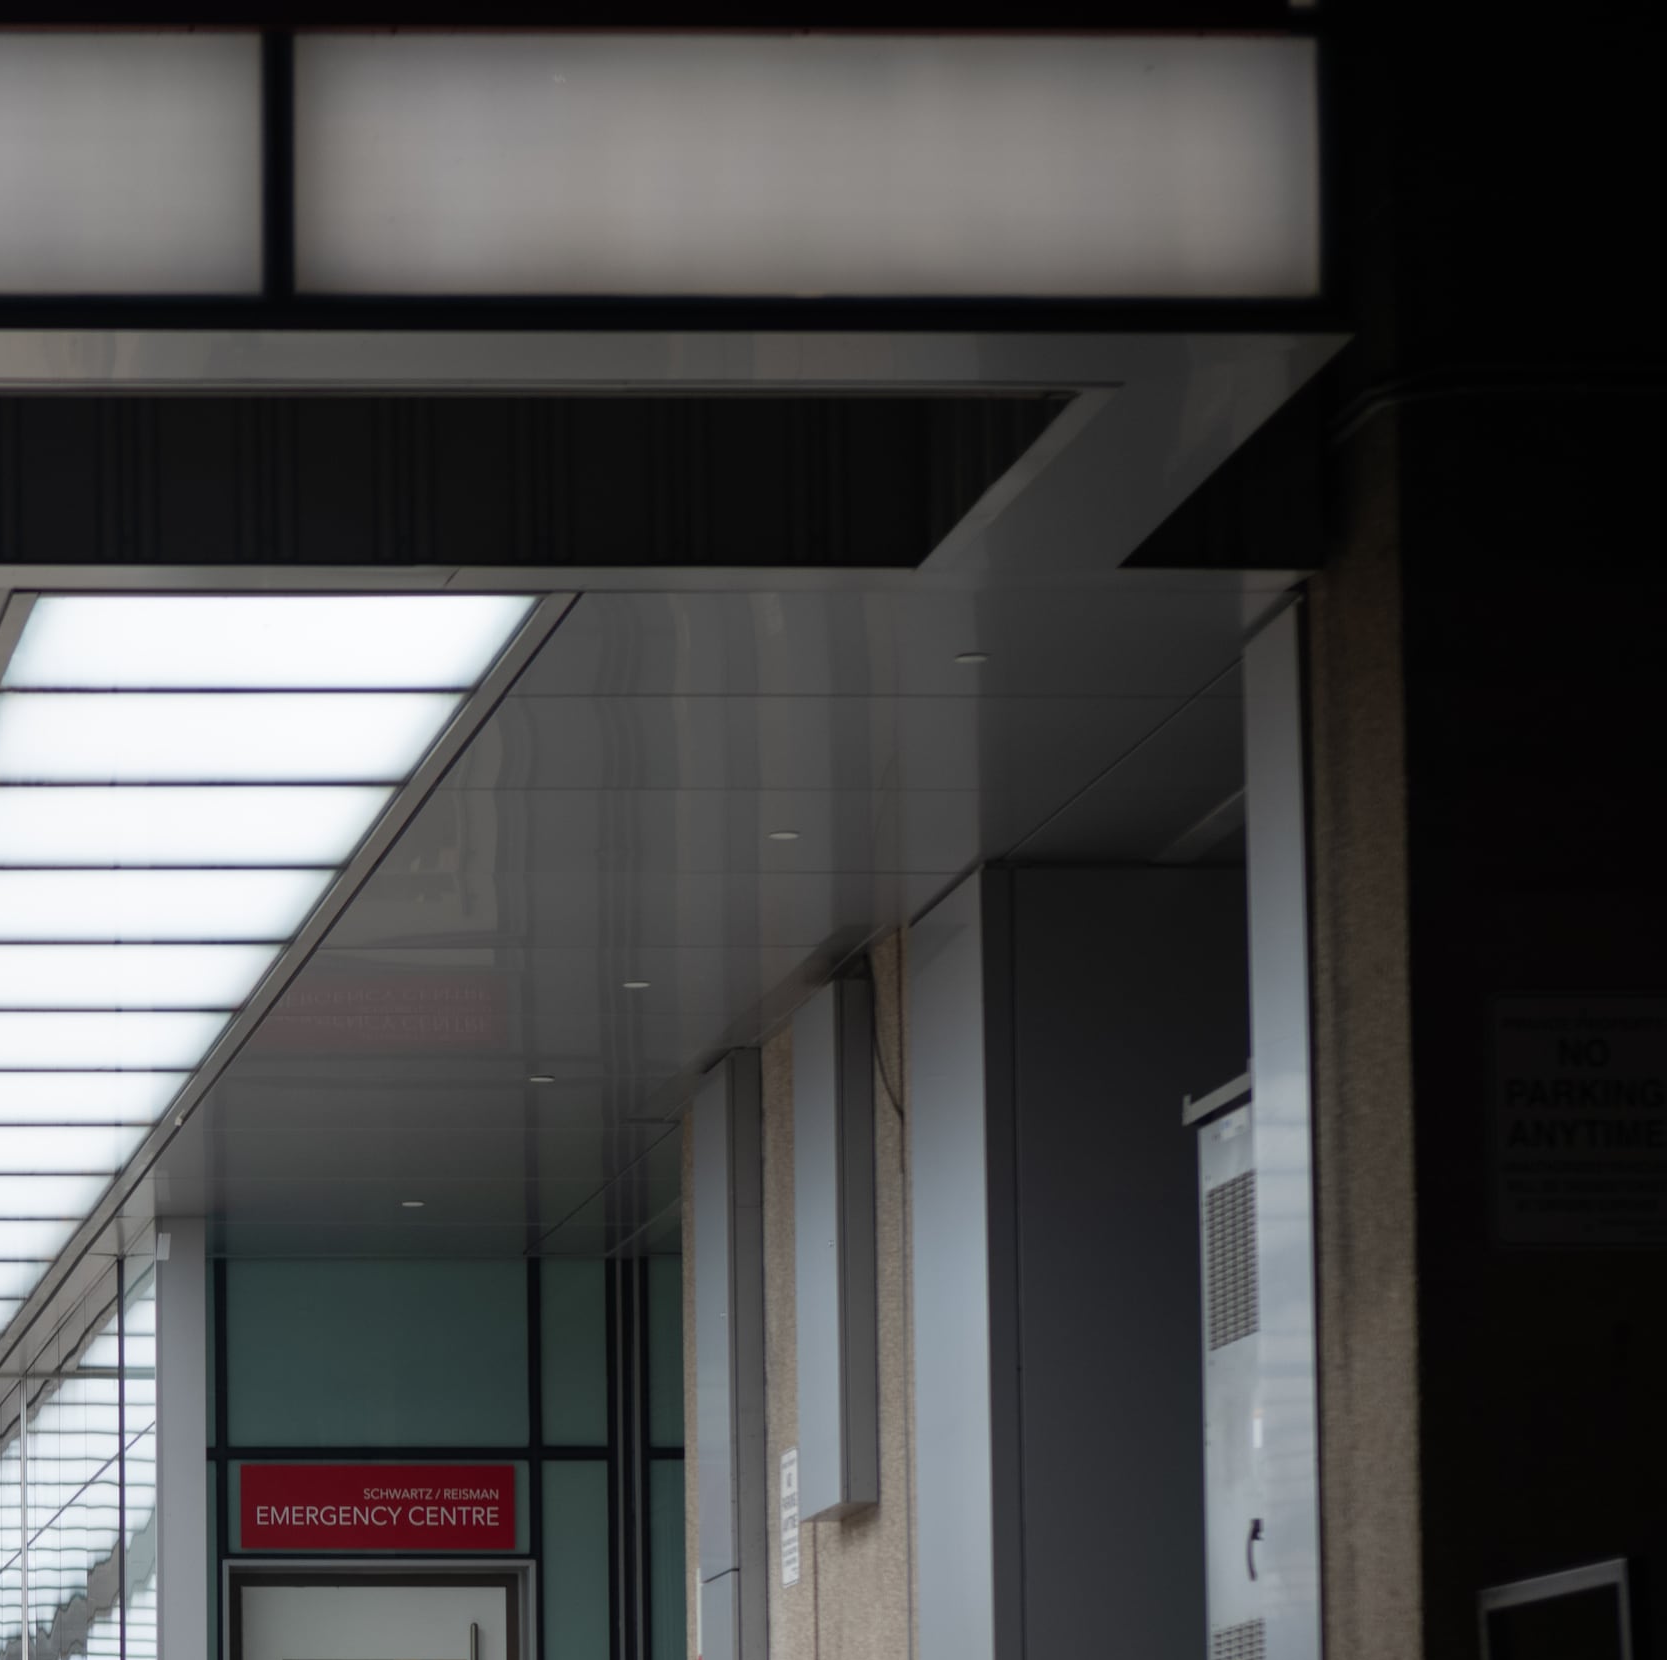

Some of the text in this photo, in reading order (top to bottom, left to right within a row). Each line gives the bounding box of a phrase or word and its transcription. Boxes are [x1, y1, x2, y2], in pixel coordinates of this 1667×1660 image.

[1505, 1078, 1665, 1108] PARKING
[363, 1488, 433, 1500] SCHWARTZ
[444, 1488, 499, 1500] REISMAN
[256, 1506, 500, 1526] EMERGENCY CENTRE
